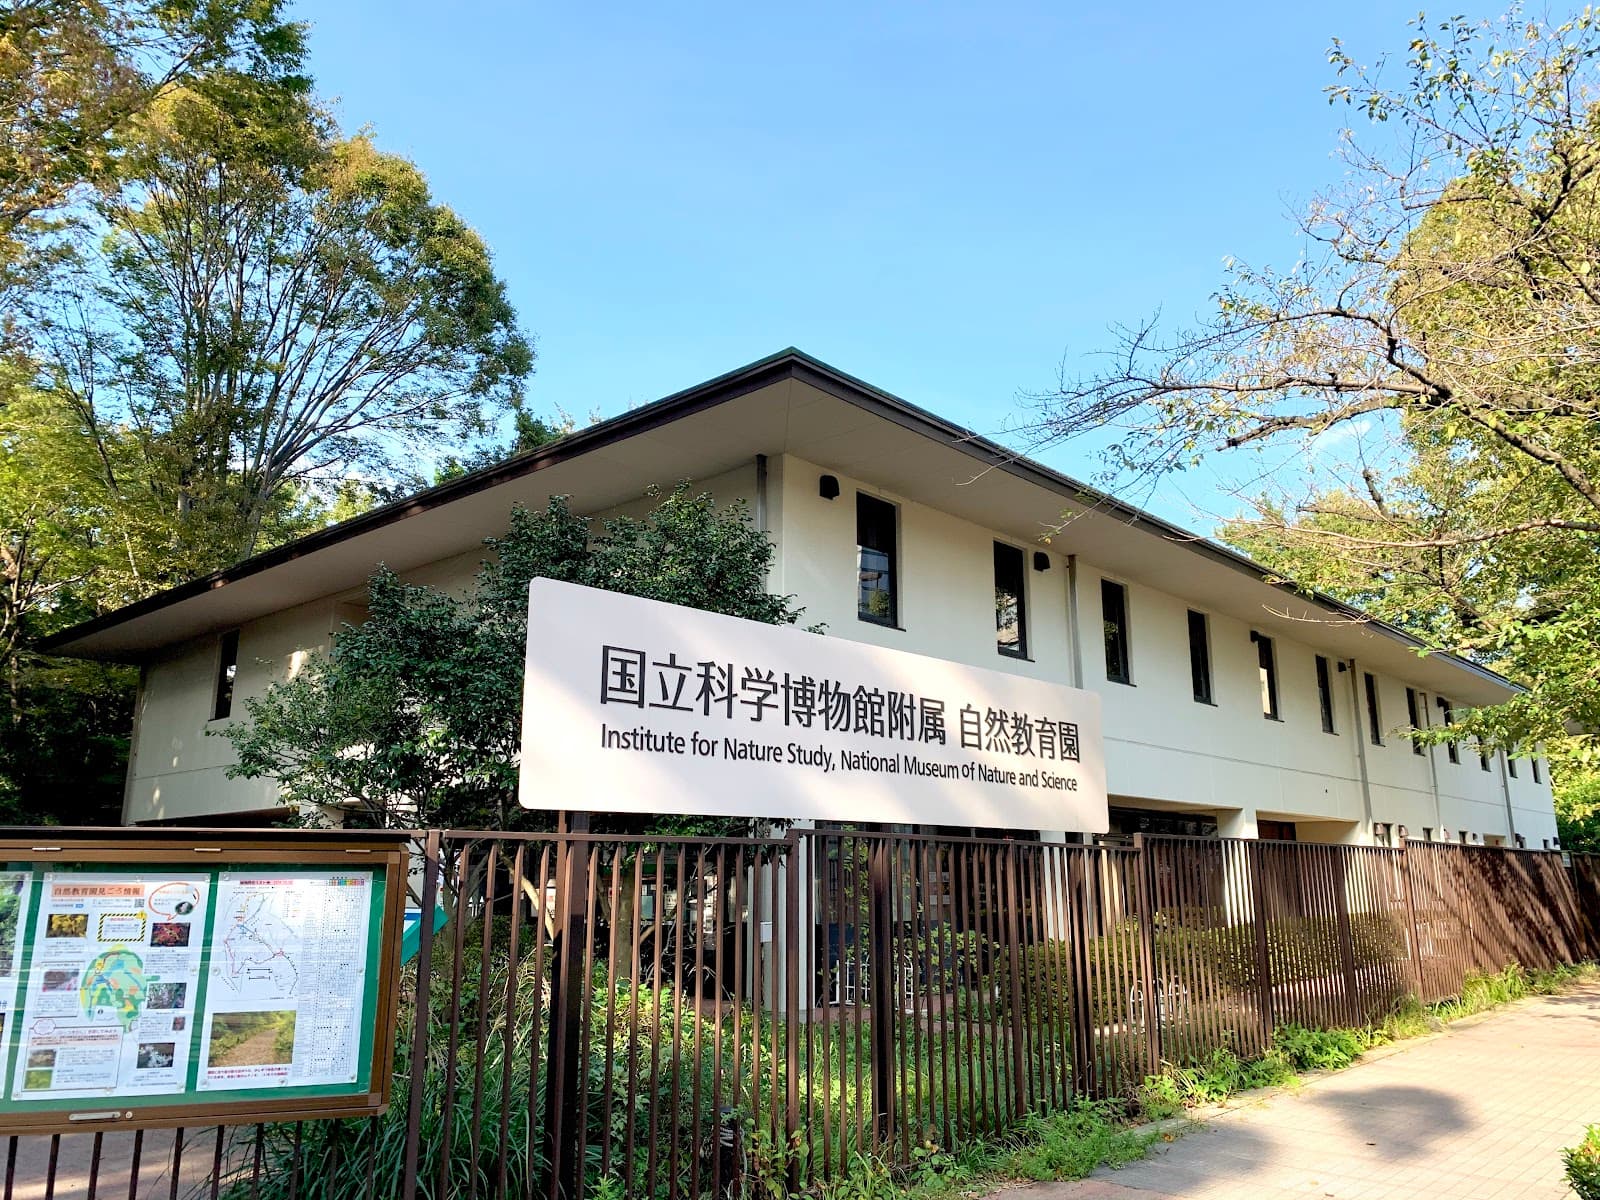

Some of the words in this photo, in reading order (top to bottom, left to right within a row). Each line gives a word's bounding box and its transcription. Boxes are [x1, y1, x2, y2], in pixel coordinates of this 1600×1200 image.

[600, 645, 946, 745] 国立科学博物館附属
[960, 703, 1080, 763] 自然教育園
[601, 723, 685, 754] Institute
[691, 731, 718, 757] for
[724, 738, 782, 763] Nature
[787, 743, 836, 772] Study,
[841, 750, 899, 773] National
[904, 755, 958, 779] Museum
[961, 762, 975, 781] of
[978, 763, 1016, 785] Nature
[1019, 769, 1038, 787] and
[1041, 771, 1077, 791] Science
